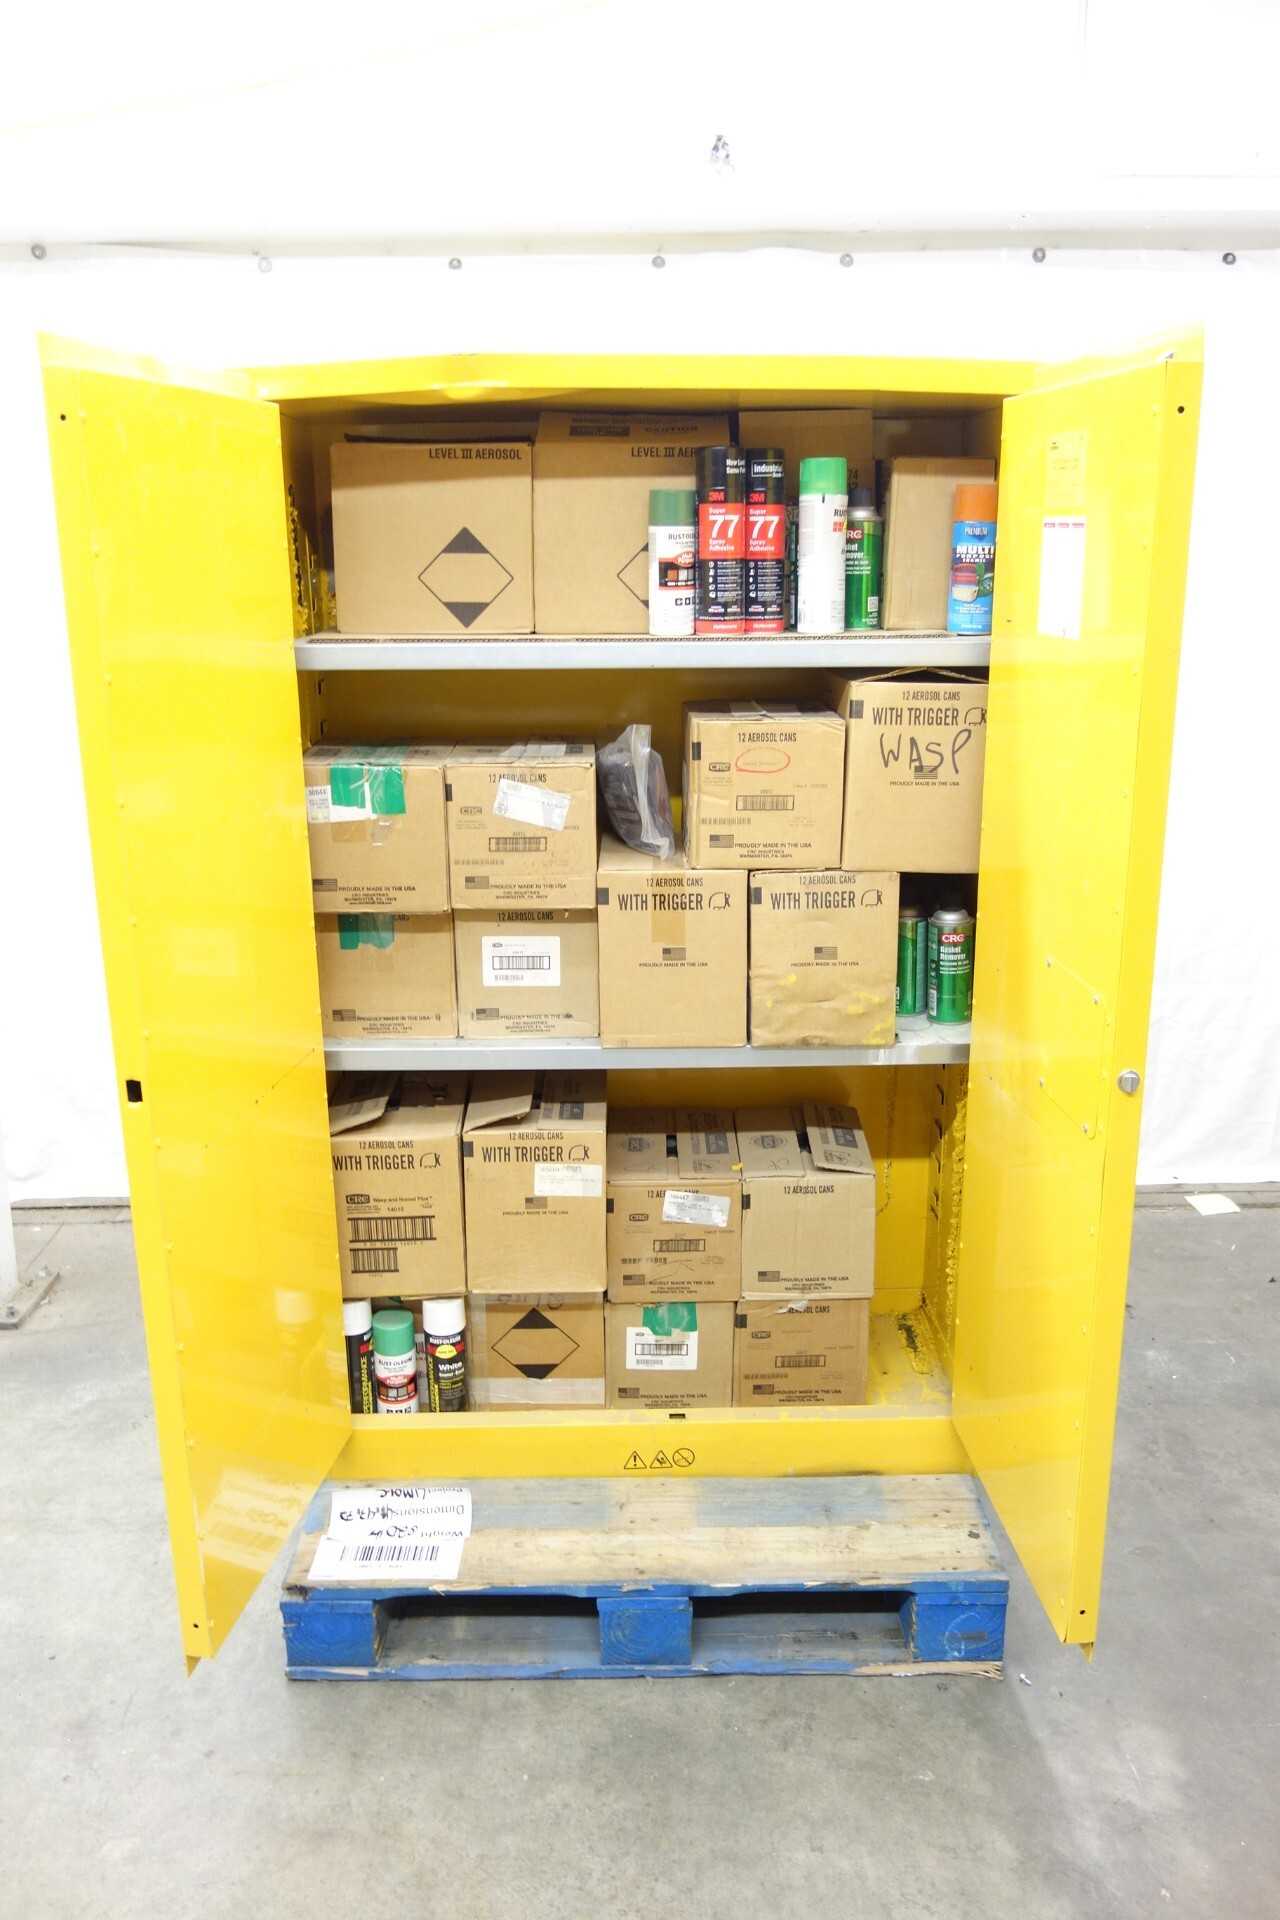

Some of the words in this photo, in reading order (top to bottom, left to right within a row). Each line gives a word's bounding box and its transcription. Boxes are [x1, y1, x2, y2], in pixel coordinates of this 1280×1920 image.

[429, 448, 459, 459] LEVEL
[462, 448, 473, 459] III
[475, 448, 522, 460] AEROSOL
[632, 447, 661, 458] LEVEL
[708, 491, 726, 502] 3M
[750, 492, 766, 503] 3M
[708, 515, 740, 539] 77
[749, 516, 780, 539] 77
[956, 544, 994, 554] MULTI
[902, 692, 910, 700] 12
[912, 692, 940, 700] AEROSOL
[943, 692, 960, 700] CANS
[872, 707, 903, 726] WITH
[908, 707, 959, 726] TRIGGER
[738, 732, 746, 742] 12
[748, 732, 777, 742] AEROSOL
[780, 732, 796, 742] CANS
[880, 729, 972, 774] WASP
[488, 774, 496, 783] 12
[646, 878, 653, 887] 12
[655, 878, 685, 887] AEROSOL
[687, 878, 704, 887] CANS
[799, 877, 806, 885] 12
[808, 876, 837, 885] AEROSOL
[839, 876, 856, 884] CANS
[618, 894, 648, 910] WITH
[652, 894, 704, 910] TRIGGER
[770, 893, 802, 910] WITH
[805, 892, 856, 909] TRIGGER
[507, 912, 535, 920] AEROSOL
[537, 912, 553, 920] CANS
[942, 934, 965, 942] CRC
[509, 1132, 516, 1140] 12
[518, 1132, 545, 1140] AEROSOL
[547, 1132, 564, 1140] CANS
[359, 1142, 366, 1150] 12
[368, 1141, 396, 1150] AEROSOL
[397, 1140, 414, 1149] CANS
[482, 1146, 511, 1163] WITH
[514, 1146, 564, 1162] TRIGGER
[332, 1156, 362, 1170] WITH
[365, 1154, 415, 1170] TRIGGER
[784, 1186, 791, 1194] 12
[792, 1185, 817, 1194] AEROSOL
[819, 1184, 834, 1194] CANS
[438, 1362, 463, 1372] White
